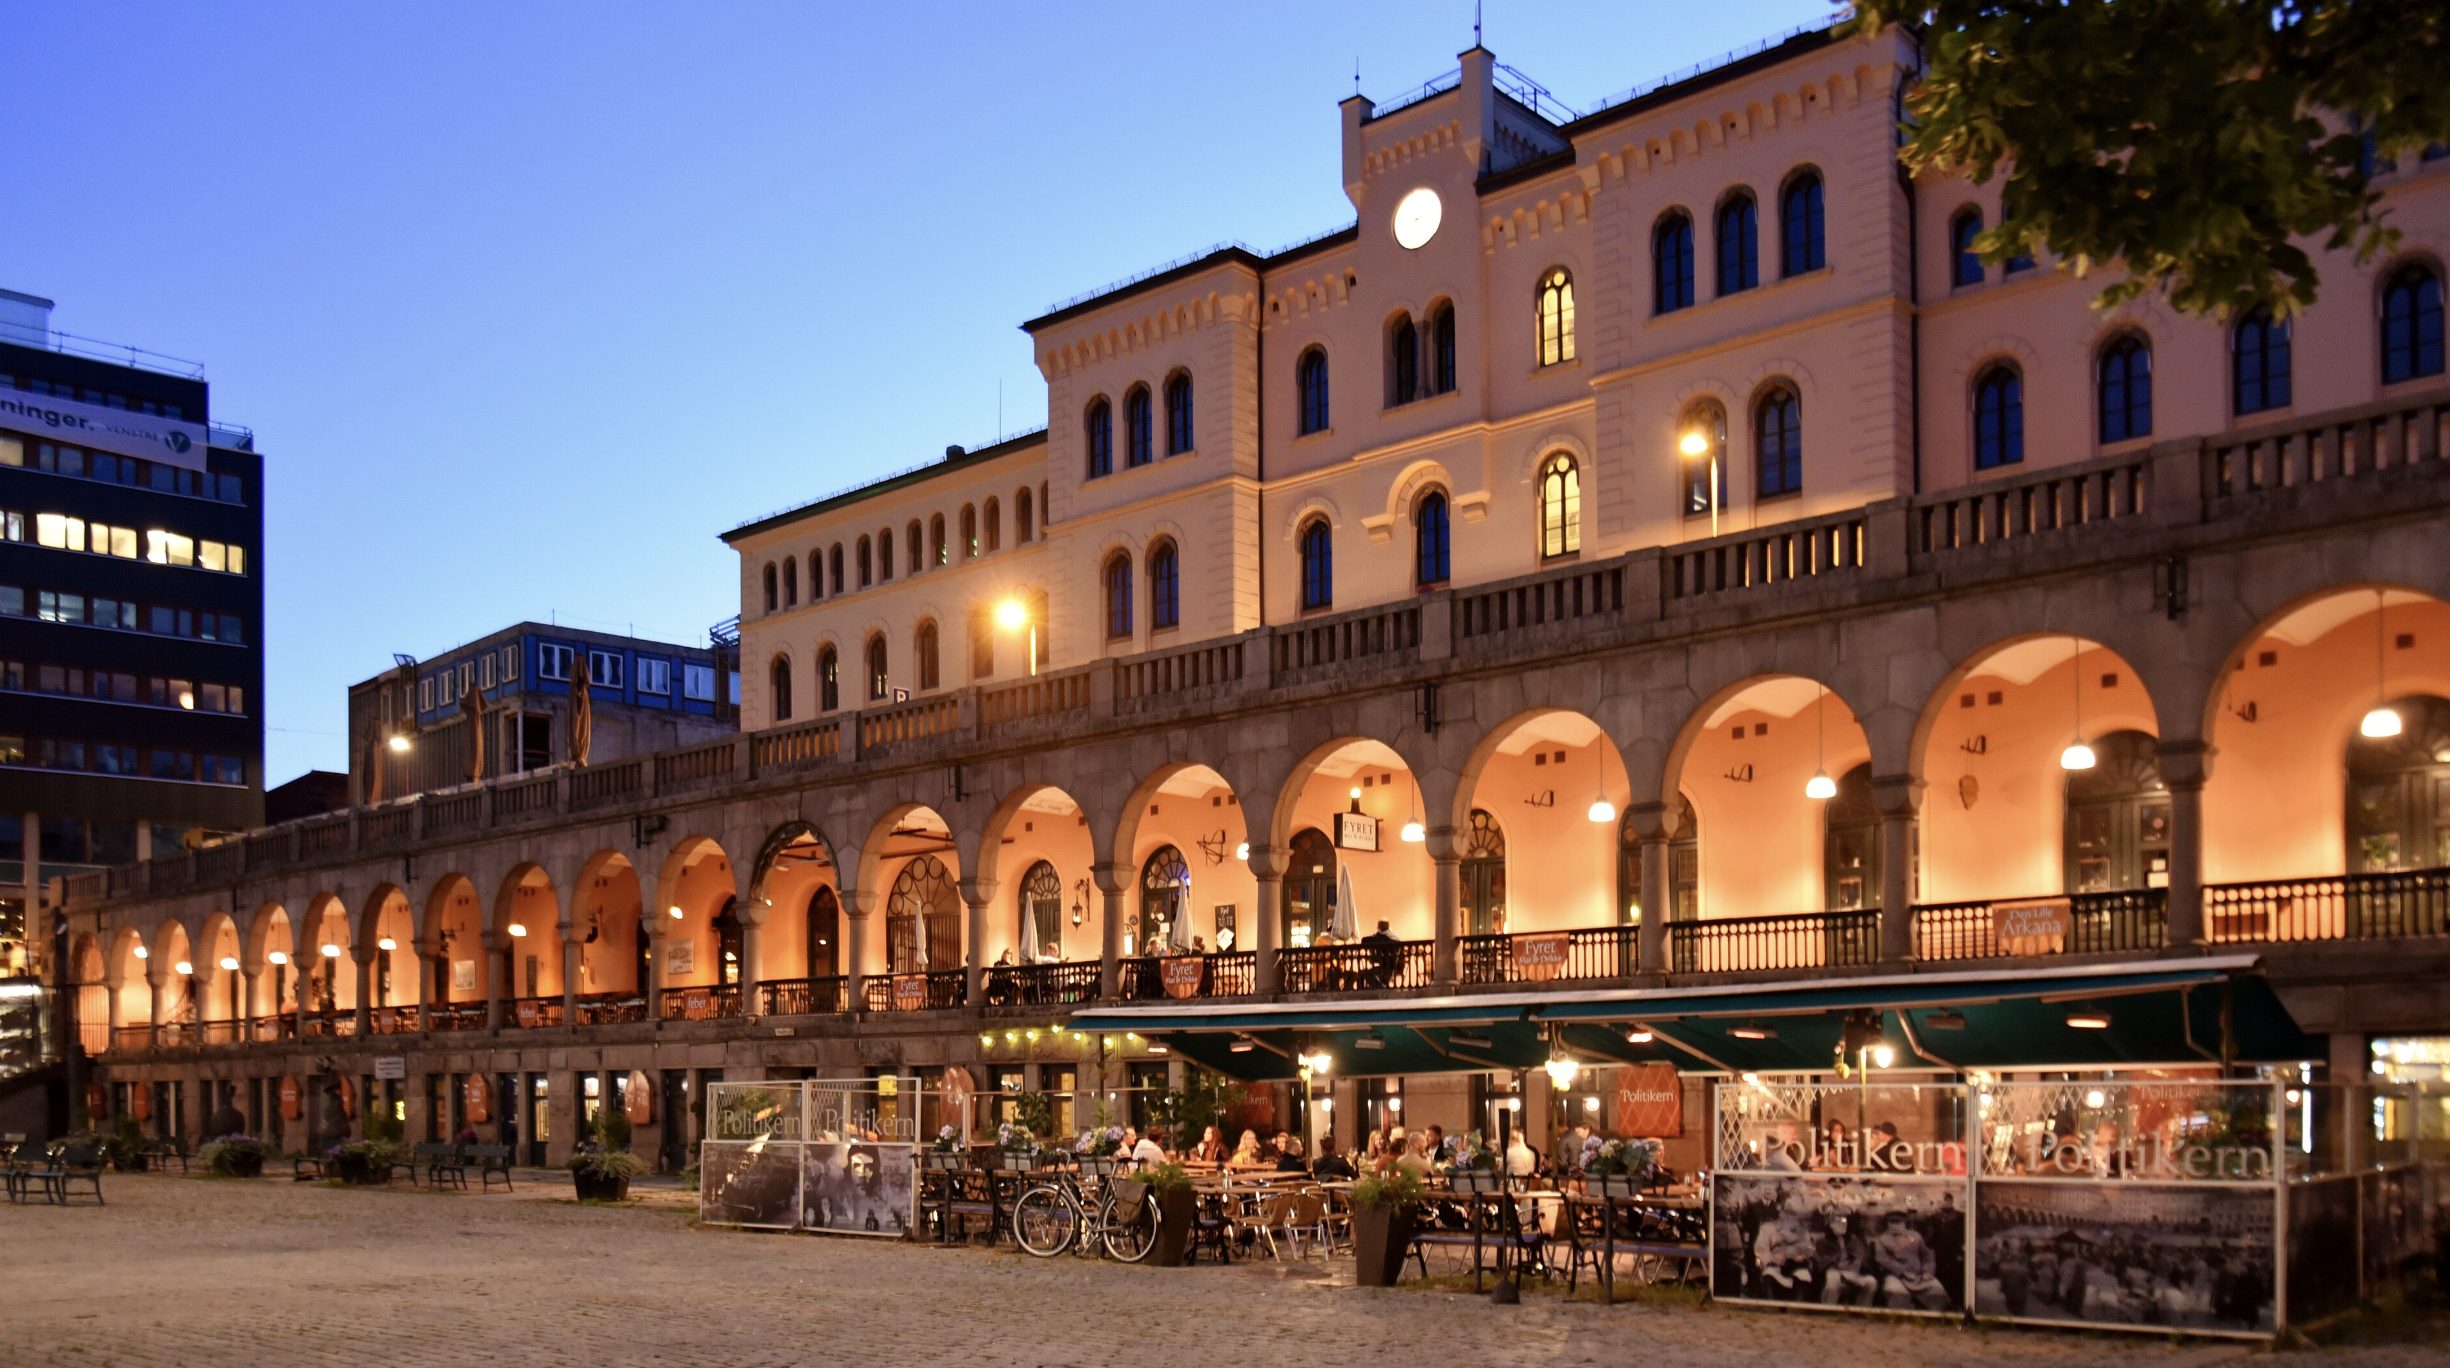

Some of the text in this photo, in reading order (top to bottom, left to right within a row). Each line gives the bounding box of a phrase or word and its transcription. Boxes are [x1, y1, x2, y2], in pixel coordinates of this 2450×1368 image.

[104, 424, 160, 443] VENSTRE
[896, 690, 907, 704] P
[1344, 821, 1374, 835] FYRET
[2010, 907, 2054, 921] Den Lille
[2002, 917, 2062, 937] Arkana
[1525, 940, 1556, 957] Fyret
[1170, 962, 1194, 978] Fyret
[900, 979, 919, 993] Fyret
[688, 996, 707, 1009] feber
[1622, 1088, 1674, 1103] Politikern
[723, 1110, 801, 1136] Politikern
[825, 1108, 916, 1137] Poitikern
[1758, 1126, 1965, 1171] Politikern
[2027, 1129, 2273, 1178] Politikern
